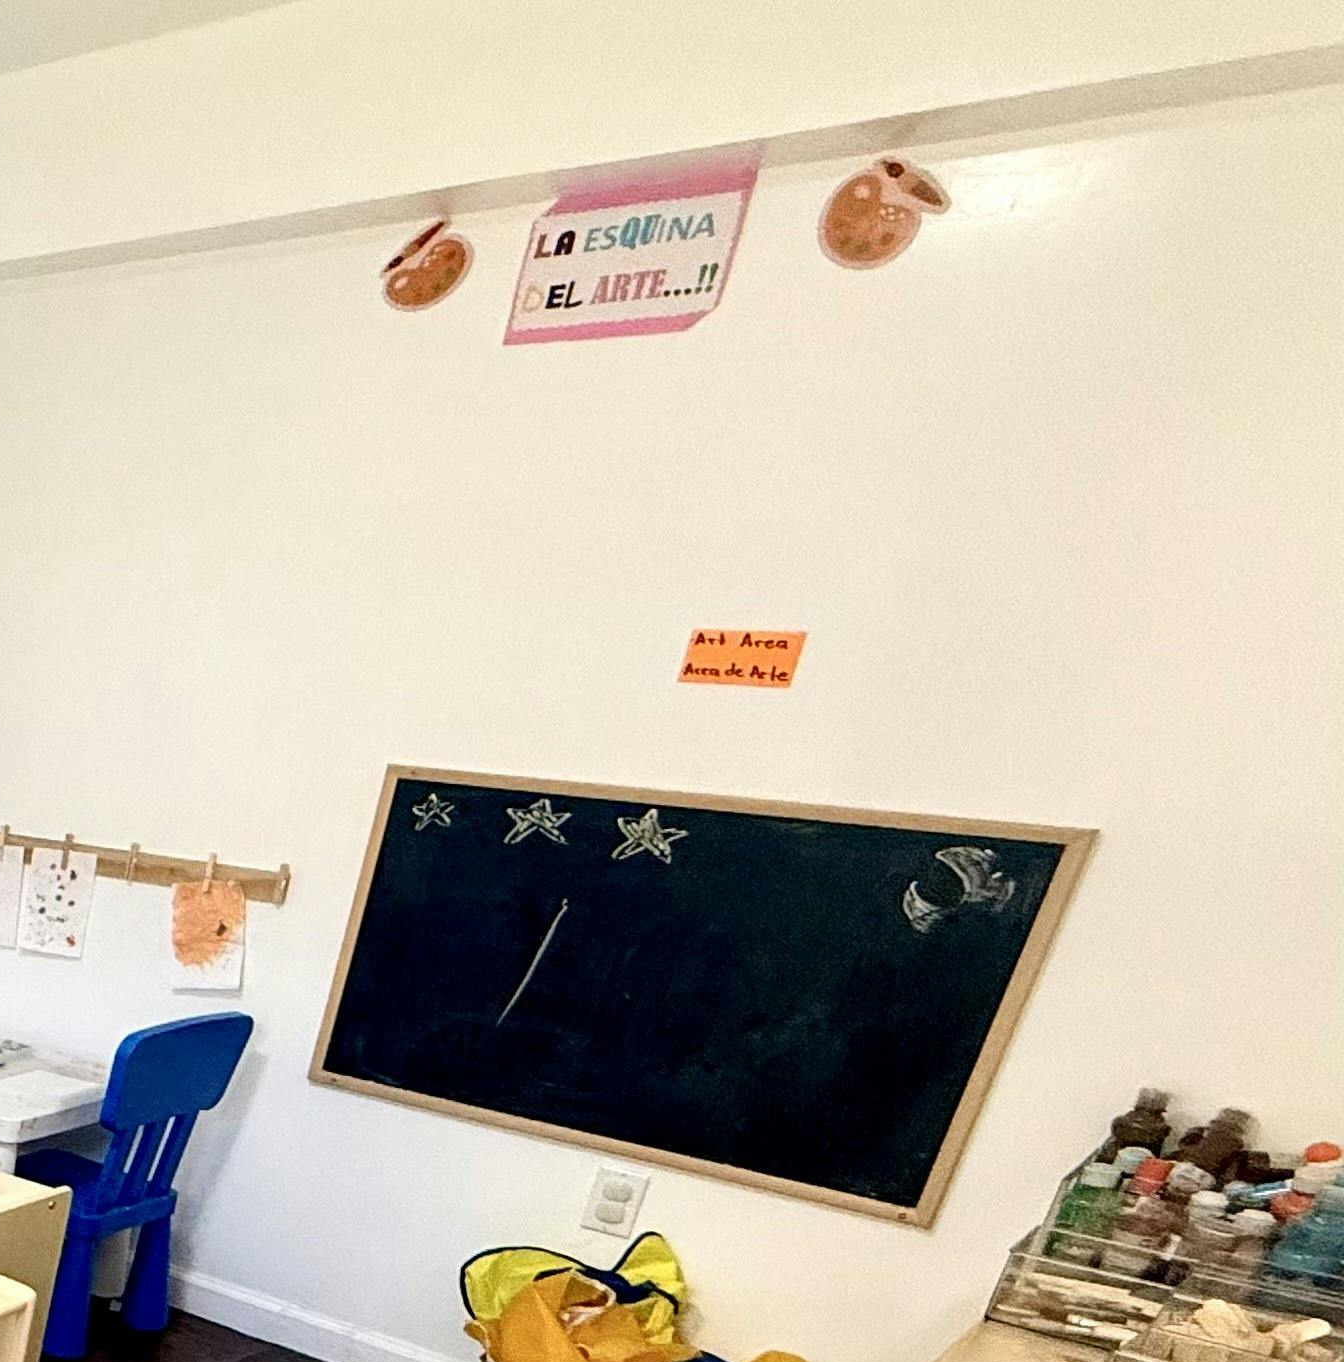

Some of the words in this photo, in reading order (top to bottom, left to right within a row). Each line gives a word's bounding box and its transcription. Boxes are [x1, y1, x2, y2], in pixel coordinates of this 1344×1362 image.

[533, 230, 576, 259] LA
[583, 213, 716, 252] ESQUINA
[521, 281, 583, 314] DEL
[694, 632, 726, 646] Art
[740, 632, 788, 650] Area
[724, 662, 745, 678] de
[749, 665, 789, 682] Arte
